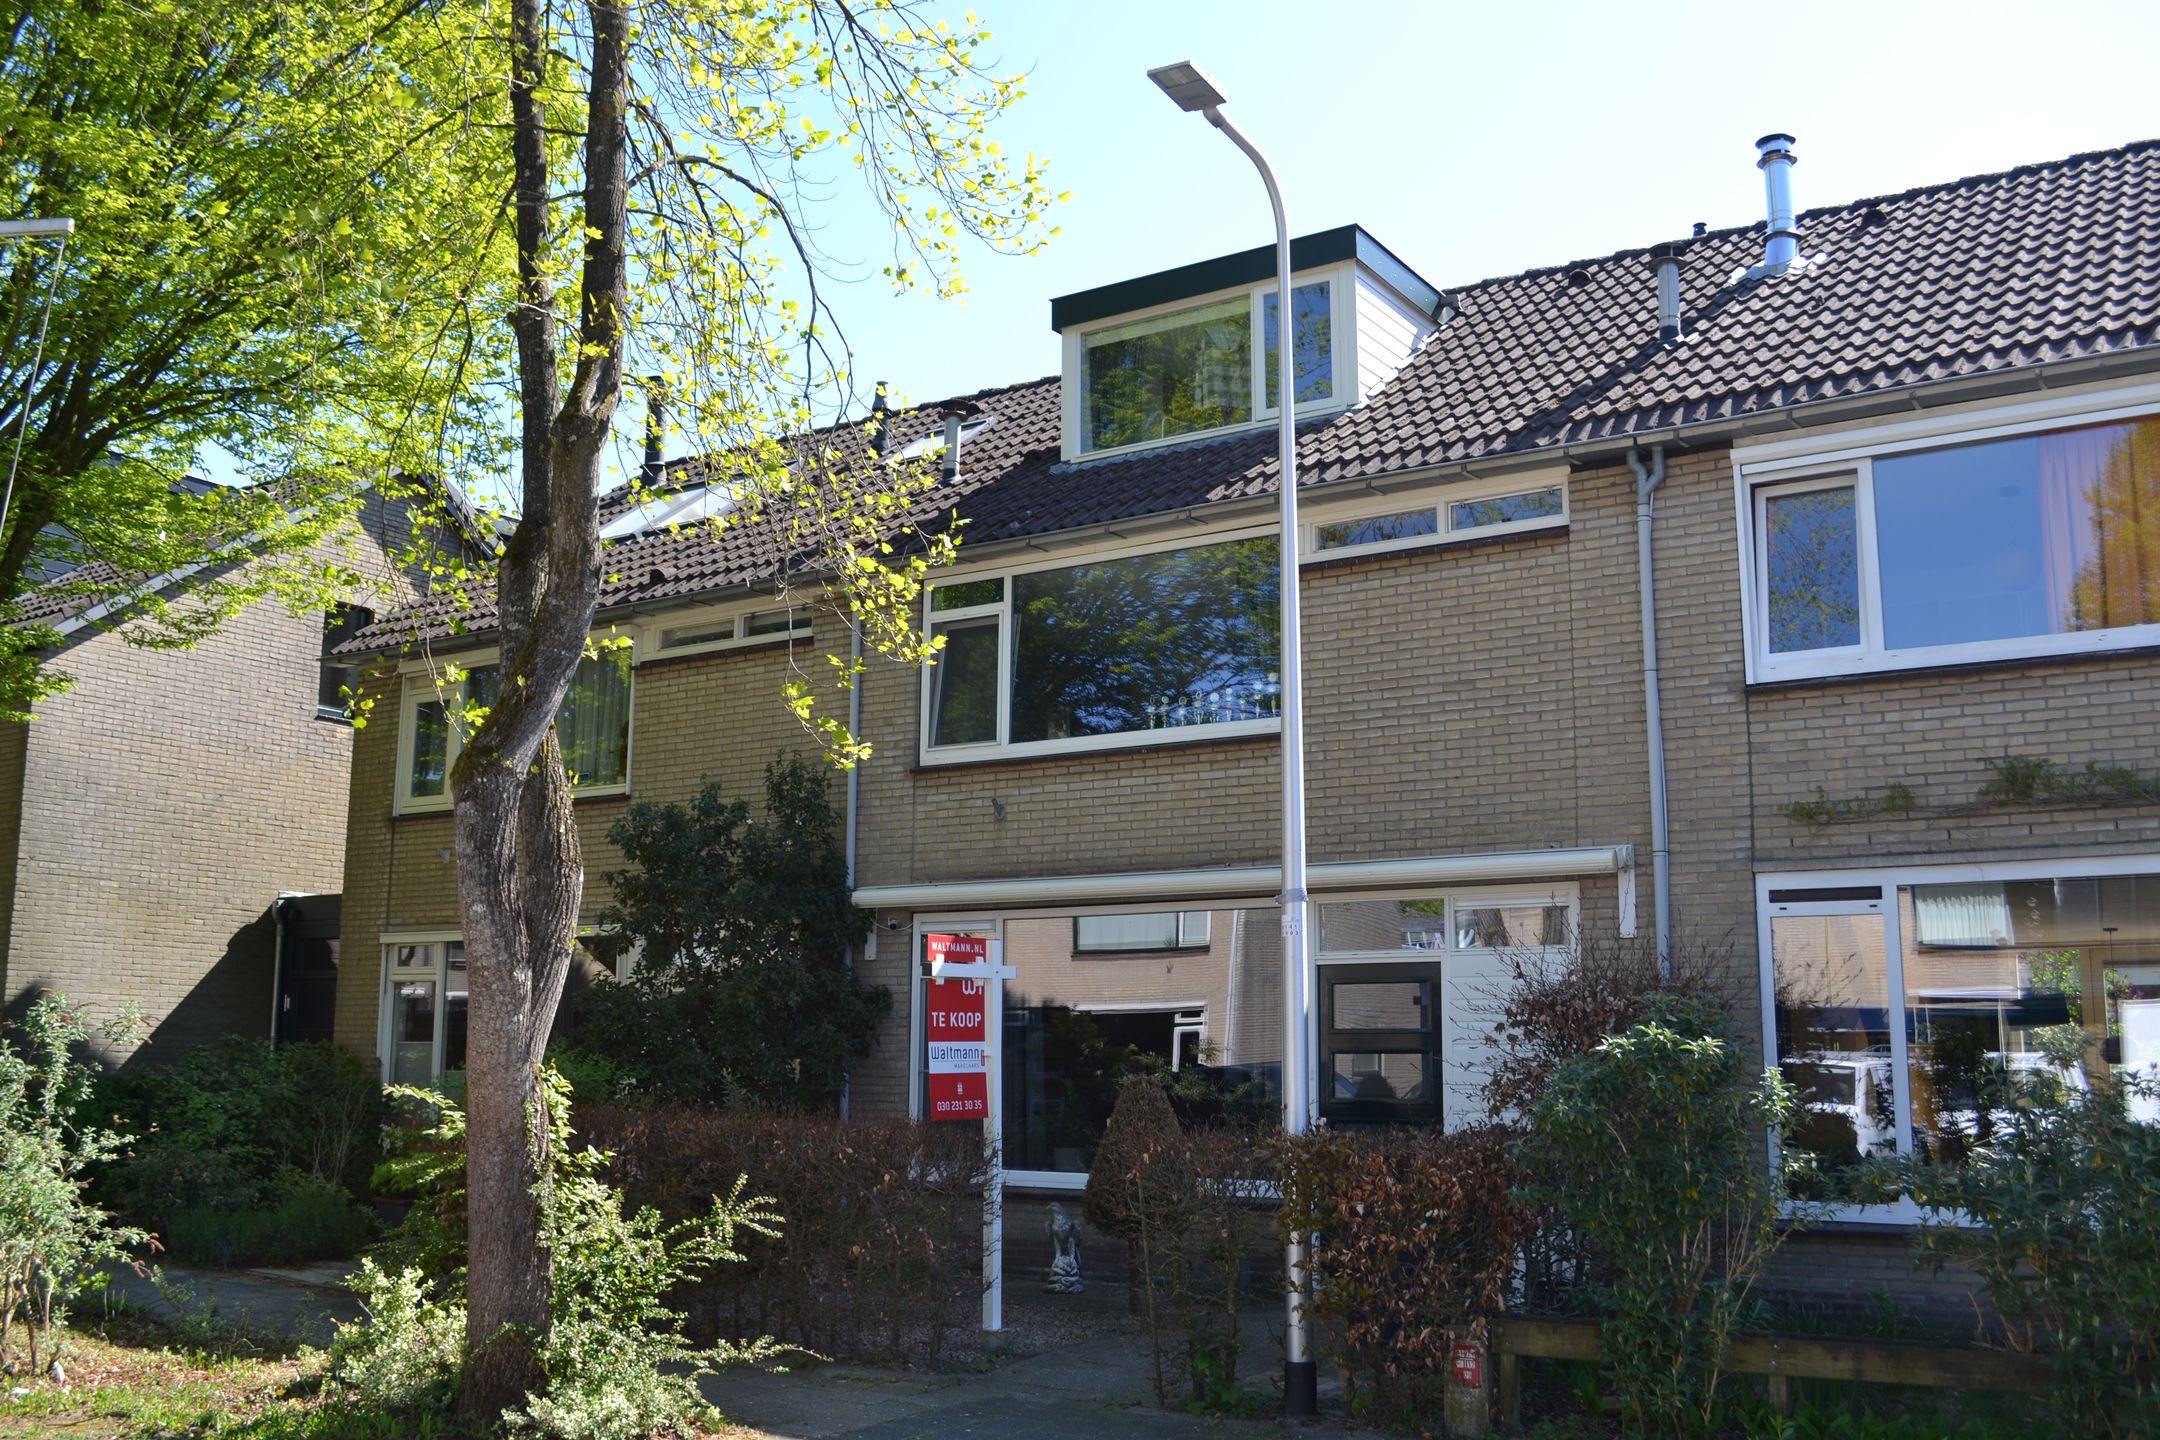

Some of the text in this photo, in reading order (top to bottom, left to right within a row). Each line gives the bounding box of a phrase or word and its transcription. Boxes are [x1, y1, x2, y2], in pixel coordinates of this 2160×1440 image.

[931, 941, 984, 954] WALTMANN.NL
[931, 1011, 982, 1028] TE KOOP
[930, 1046, 980, 1060] Waltmann
[936, 1099, 983, 1112] 030 231 30 35
